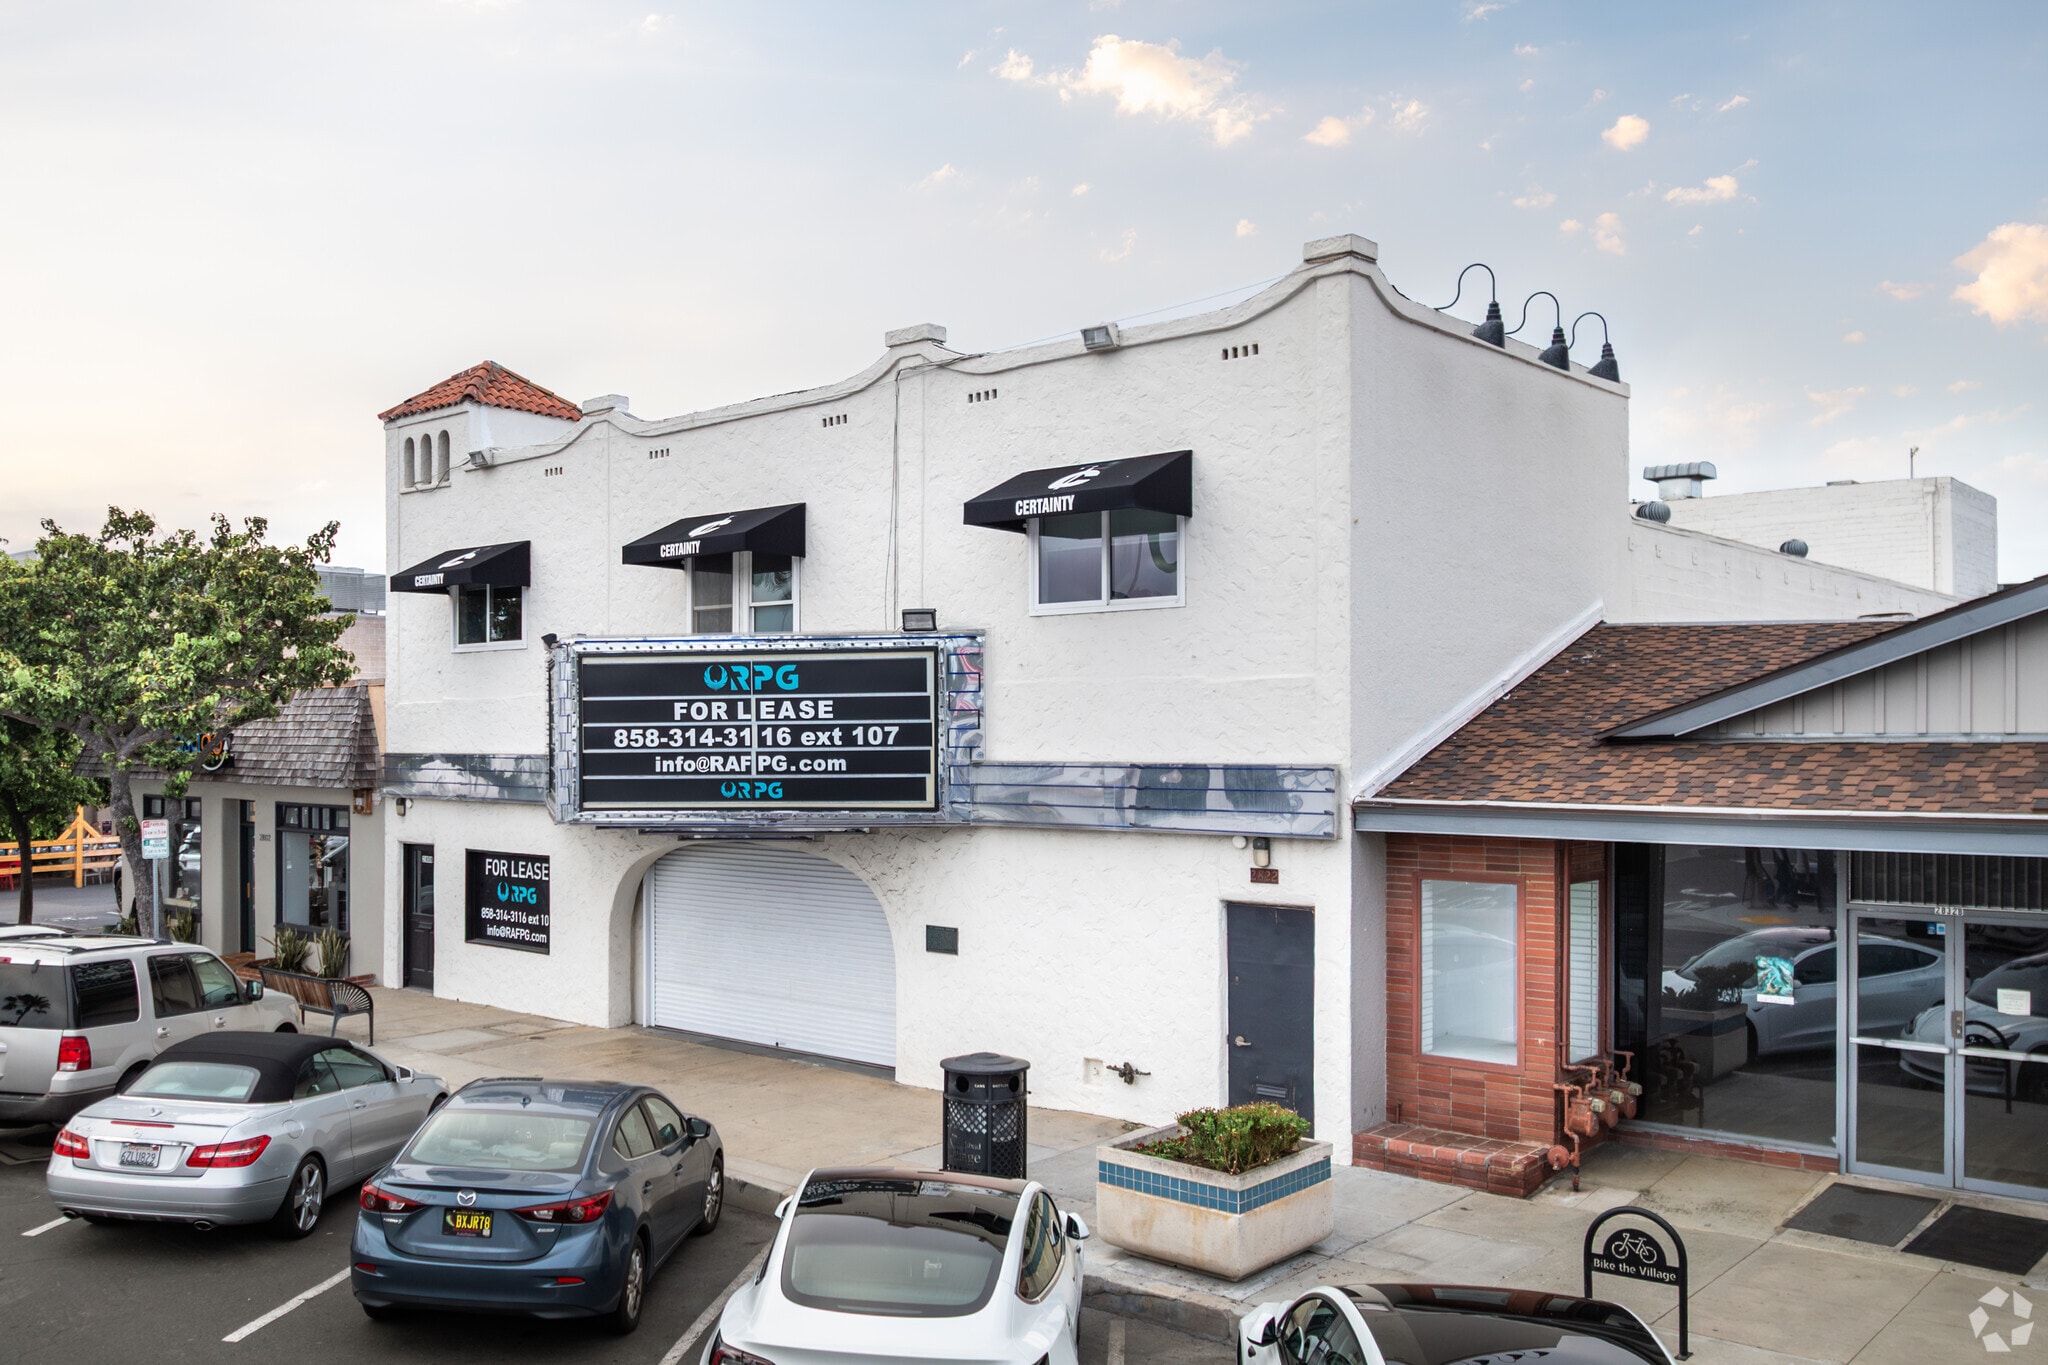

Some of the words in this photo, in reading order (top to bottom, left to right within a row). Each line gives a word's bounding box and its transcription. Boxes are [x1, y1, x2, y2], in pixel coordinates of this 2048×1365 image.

[1015, 495, 1075, 516] CERTAINTY
[660, 540, 700, 558] CERTAINTY
[414, 573, 444, 587] CERTAINTY
[730, 664, 799, 691] RPG
[673, 701, 728, 721] FOR
[737, 700, 834, 720] LEASE
[613, 727, 792, 748] 858-314-3116
[800, 727, 843, 746] ext
[852, 726, 900, 746] 107
[485, 858, 508, 877] FOR
[511, 860, 549, 880] LEASE
[1251, 870, 1278, 883] 2822
[511, 885, 537, 905] RPG
[481, 907, 527, 924] 858-314-3116
[528, 914, 540, 926] ext
[487, 924, 547, 943] info@RAFPG.com
[456, 1214, 491, 1230] BXJR78
[1593, 1258, 1616, 1271] Bike
[1619, 1262, 1637, 1274] the
[1639, 1266, 1677, 1282] Village
